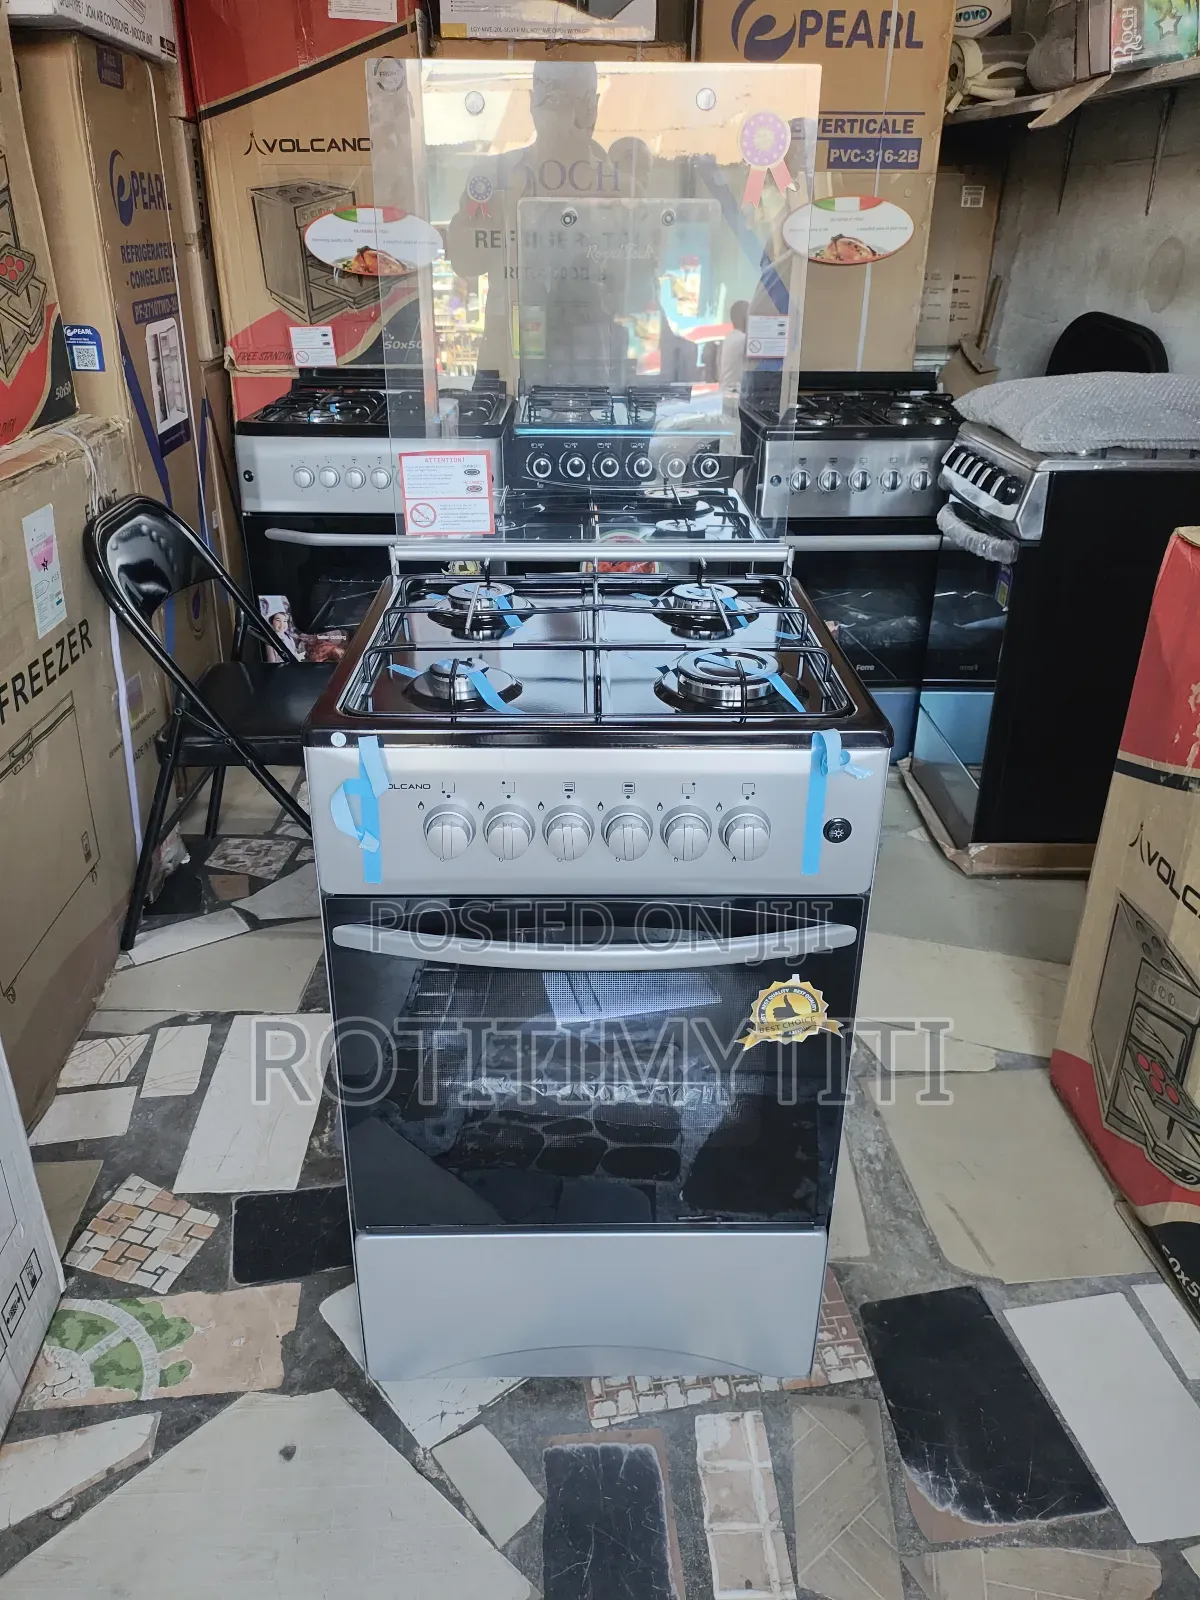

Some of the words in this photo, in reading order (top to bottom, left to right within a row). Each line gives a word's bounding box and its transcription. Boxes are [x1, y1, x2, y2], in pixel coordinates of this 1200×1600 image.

[797, 9, 924, 49] PEARL
[73, 328, 93, 336] PEARL
[237, 351, 258, 361] FREE
[258, 351, 293, 361] STANDIN
[424, 456, 465, 464] ATTENTION!
[0, 618, 93, 727] FREEZER
[1146, 839, 1200, 920] VOLC
[768, 988, 790, 1001] QUALITY
[759, 1023, 780, 1034] BEST
[782, 1015, 816, 1029] CHOICE
[1161, 1243, 1200, 1306] 0x5
